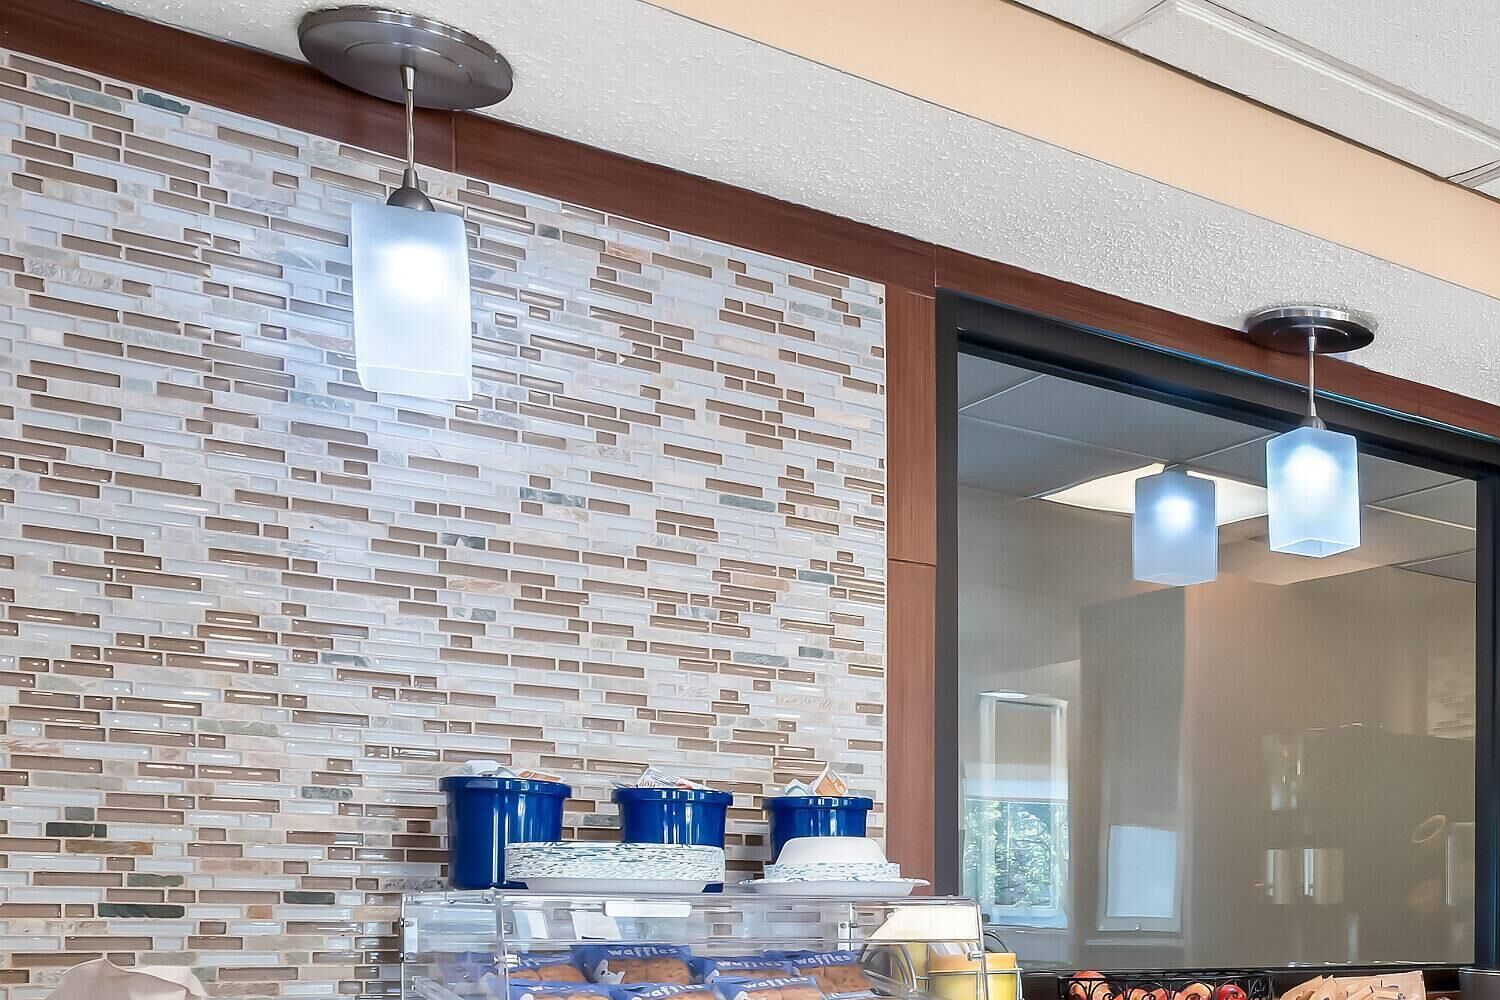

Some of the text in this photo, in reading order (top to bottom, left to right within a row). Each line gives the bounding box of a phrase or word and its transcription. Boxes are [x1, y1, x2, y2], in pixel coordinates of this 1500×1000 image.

[607, 946, 678, 958] waffles
[794, 953, 852, 966] waffles
[743, 975, 809, 990] waffles
